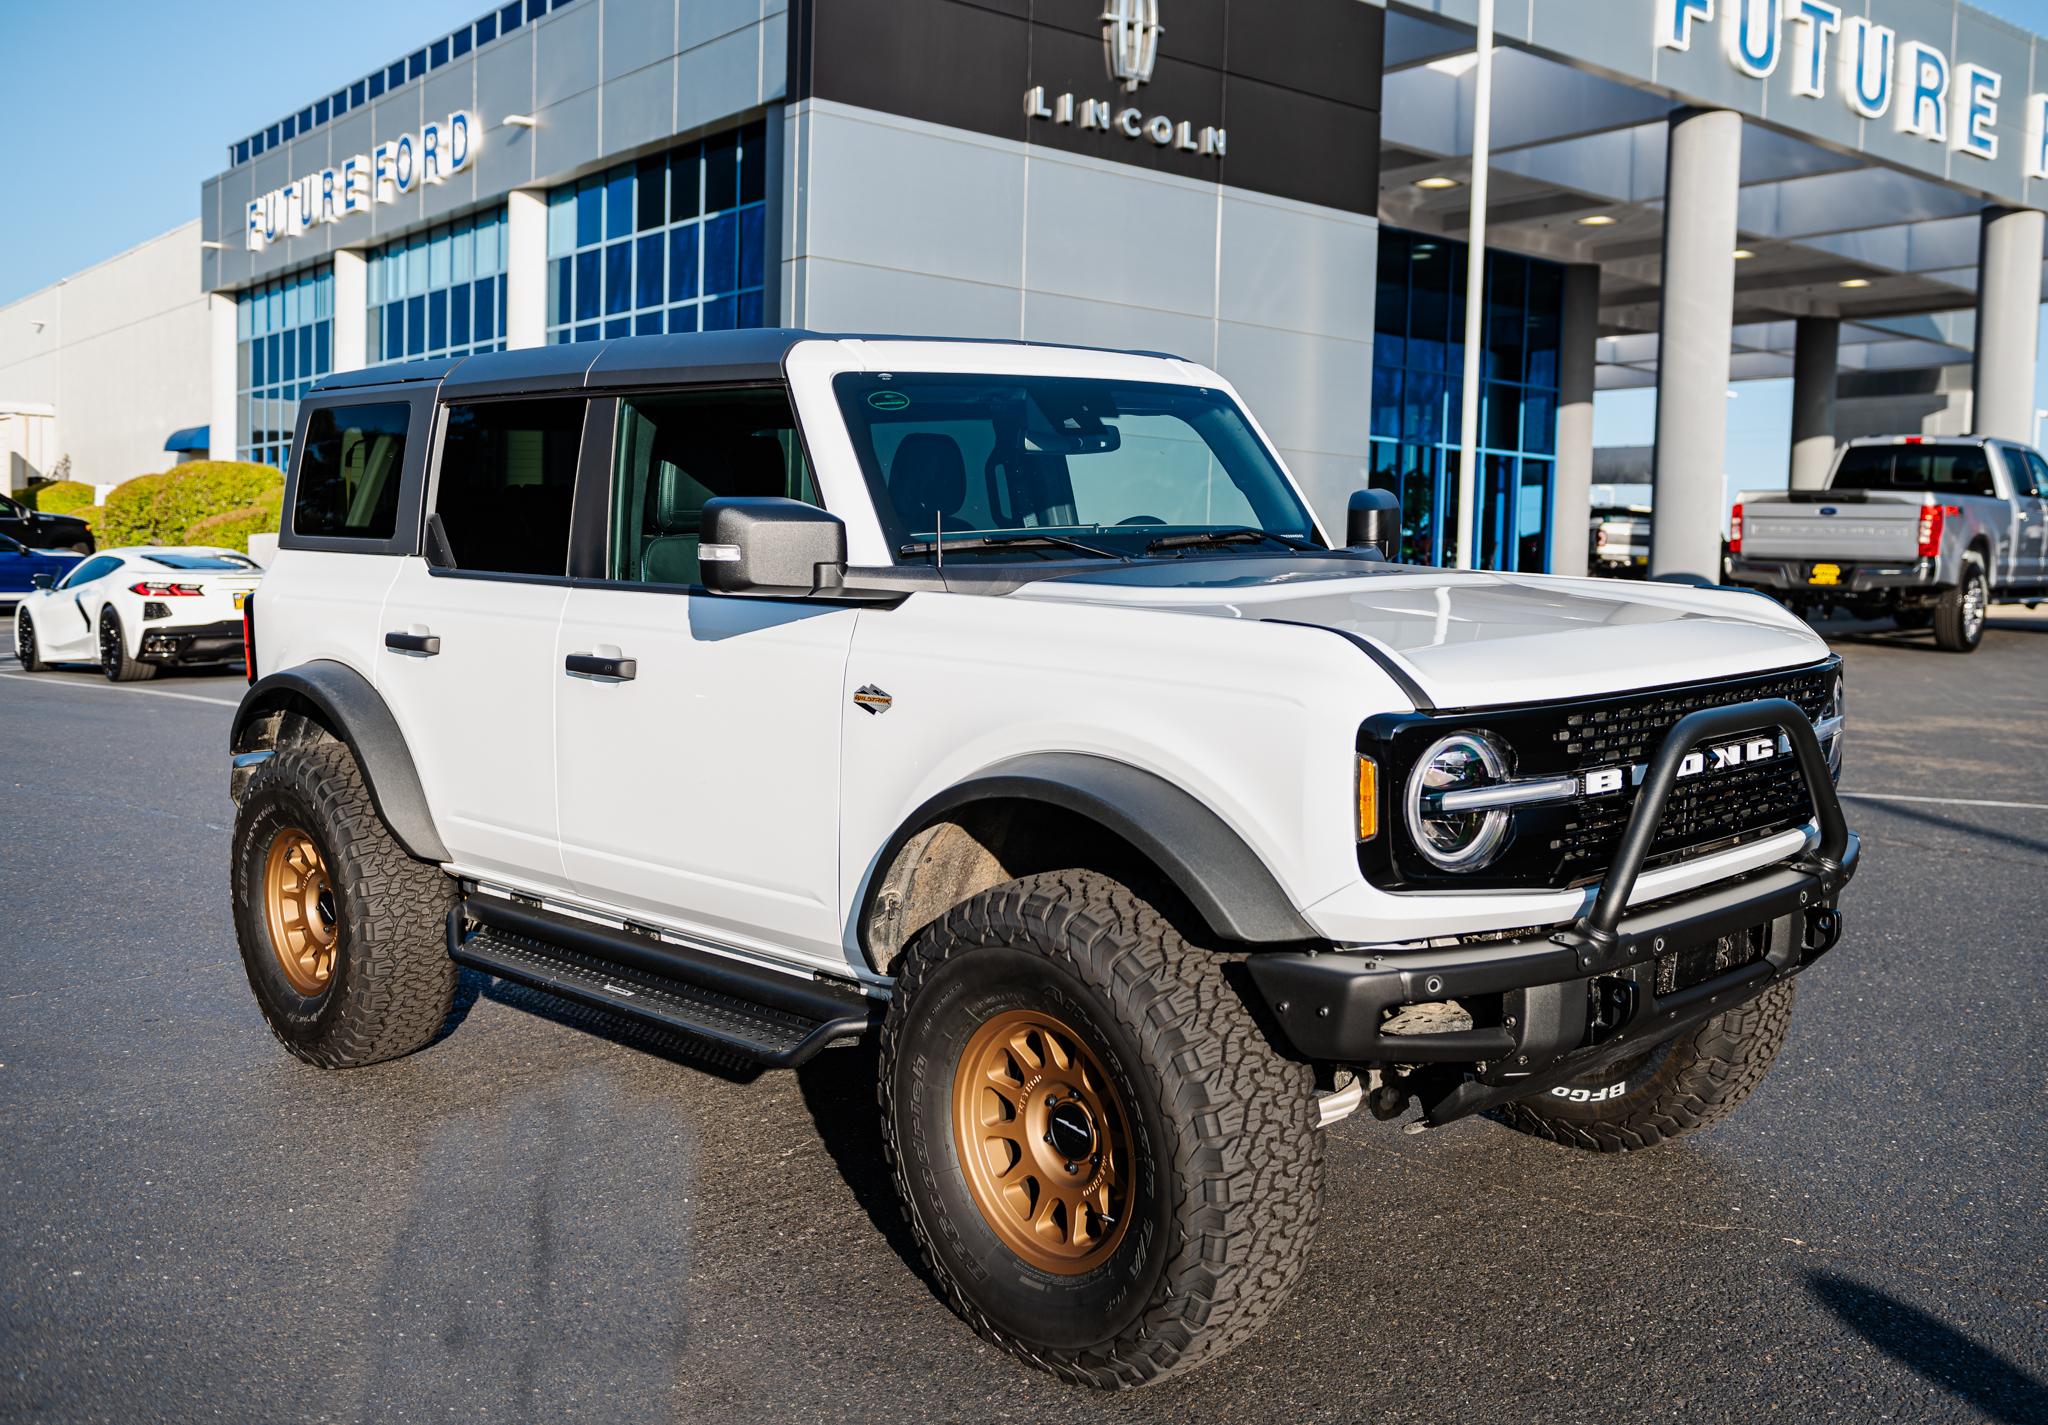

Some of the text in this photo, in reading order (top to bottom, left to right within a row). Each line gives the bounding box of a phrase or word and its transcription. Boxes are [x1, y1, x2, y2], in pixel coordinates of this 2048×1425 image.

[1026, 86, 1226, 156] LINCOLN
[246, 110, 474, 251] FUTURE FORD
